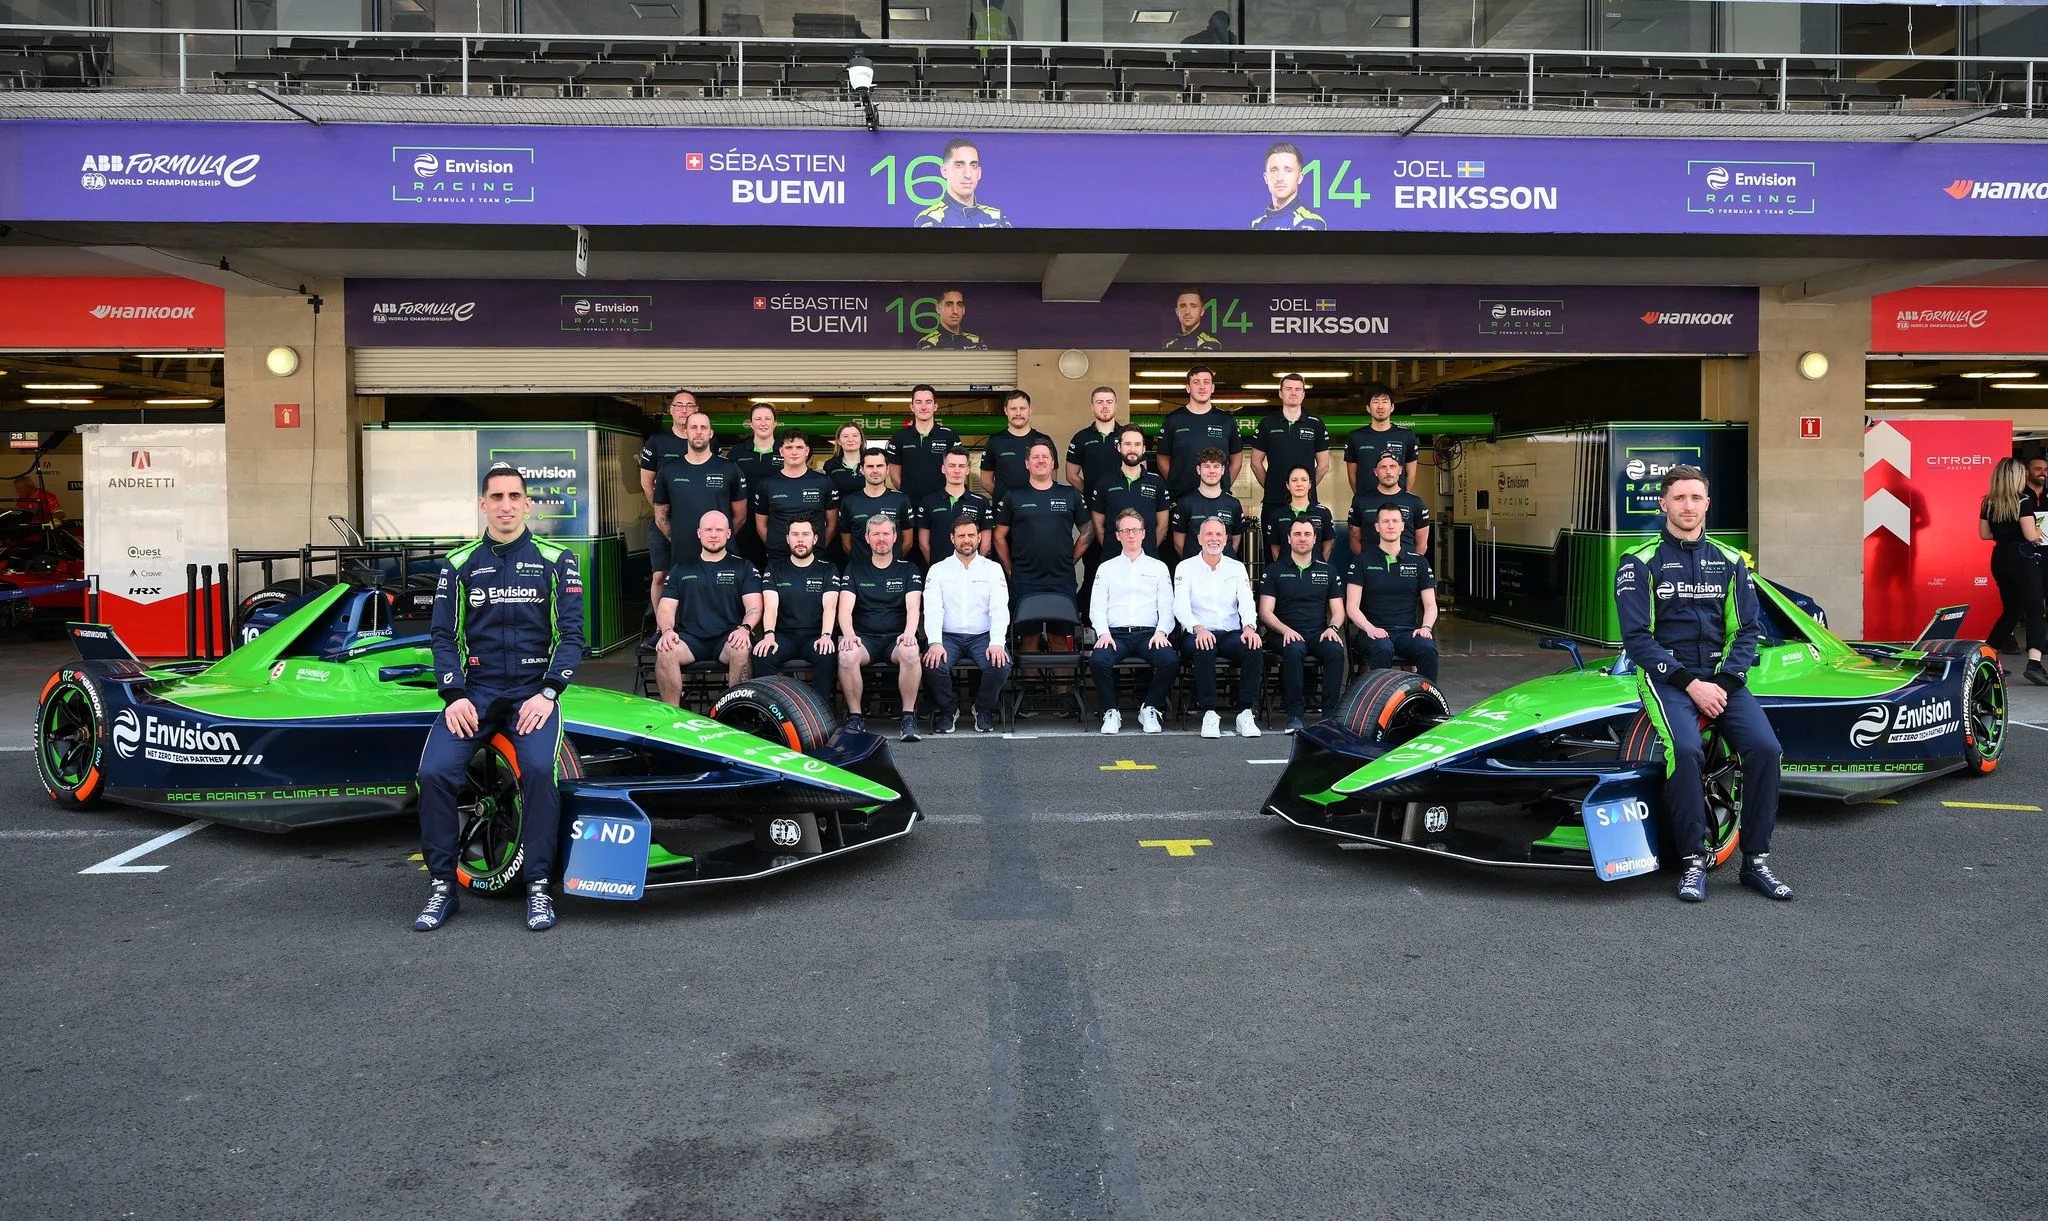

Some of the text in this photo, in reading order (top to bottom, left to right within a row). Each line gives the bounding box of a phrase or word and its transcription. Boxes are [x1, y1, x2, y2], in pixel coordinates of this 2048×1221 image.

[81, 154, 124, 172] ABB
[125, 153, 227, 176] FORMULA
[446, 159, 514, 174] Envision
[709, 148, 845, 172] SÉBASTIEN
[1393, 160, 1452, 178] JOEL
[82, 174, 221, 188] FIA WORLD CHAMPIONSHIP
[870, 155, 948, 206] 16
[1302, 159, 1370, 209] 14
[1735, 172, 1796, 187] Envision
[414, 182, 514, 192] RACING
[732, 180, 845, 204] BUEMI
[1394, 186, 1557, 210] ERIKSSON
[1706, 194, 1796, 204] RACING
[578, 235, 588, 262] 19
[594, 302, 639, 312] Envision
[770, 293, 868, 310] SÉBASTIEN
[1269, 298, 1313, 312] JOEL
[373, 303, 397, 314] ABB
[397, 302, 454, 316] FORMULA
[885, 297, 942, 334] 16
[1202, 298, 1253, 334] 14
[1510, 306, 1552, 318] Envision
[1896, 310, 1918, 321] ABB
[1918, 310, 1970, 322] FORMULA
[790, 316, 868, 333] BUEMI
[1270, 317, 1389, 334] ERIKSSON
[1236, 418, 1256, 430] RI
[1926, 454, 1992, 464] CITROËN
[518, 466, 576, 478] Envision
[108, 478, 175, 488] ANDRETTI
[1507, 476, 1529, 488] Envision
[526, 486, 576, 494] CING
[128, 546, 162, 558] Quest
[488, 586, 537, 598] Envision
[1677, 582, 1722, 593] Envision
[1892, 697, 1952, 730] Envision
[146, 716, 240, 751] Envision
[1890, 734, 1903, 742] NET
[1904, 733, 1918, 741] ZERO
[147, 750, 158, 758] NET
[158, 751, 172, 760] ZERO
[172, 753, 189, 762] TECH
[1781, 763, 1925, 772] GAINST CLIMATE CHANGE
[167, 786, 408, 801] RACE AGAINST CLIMATE CHANGE
[1426, 810, 1448, 830] FIA
[771, 822, 800, 844] FIA
